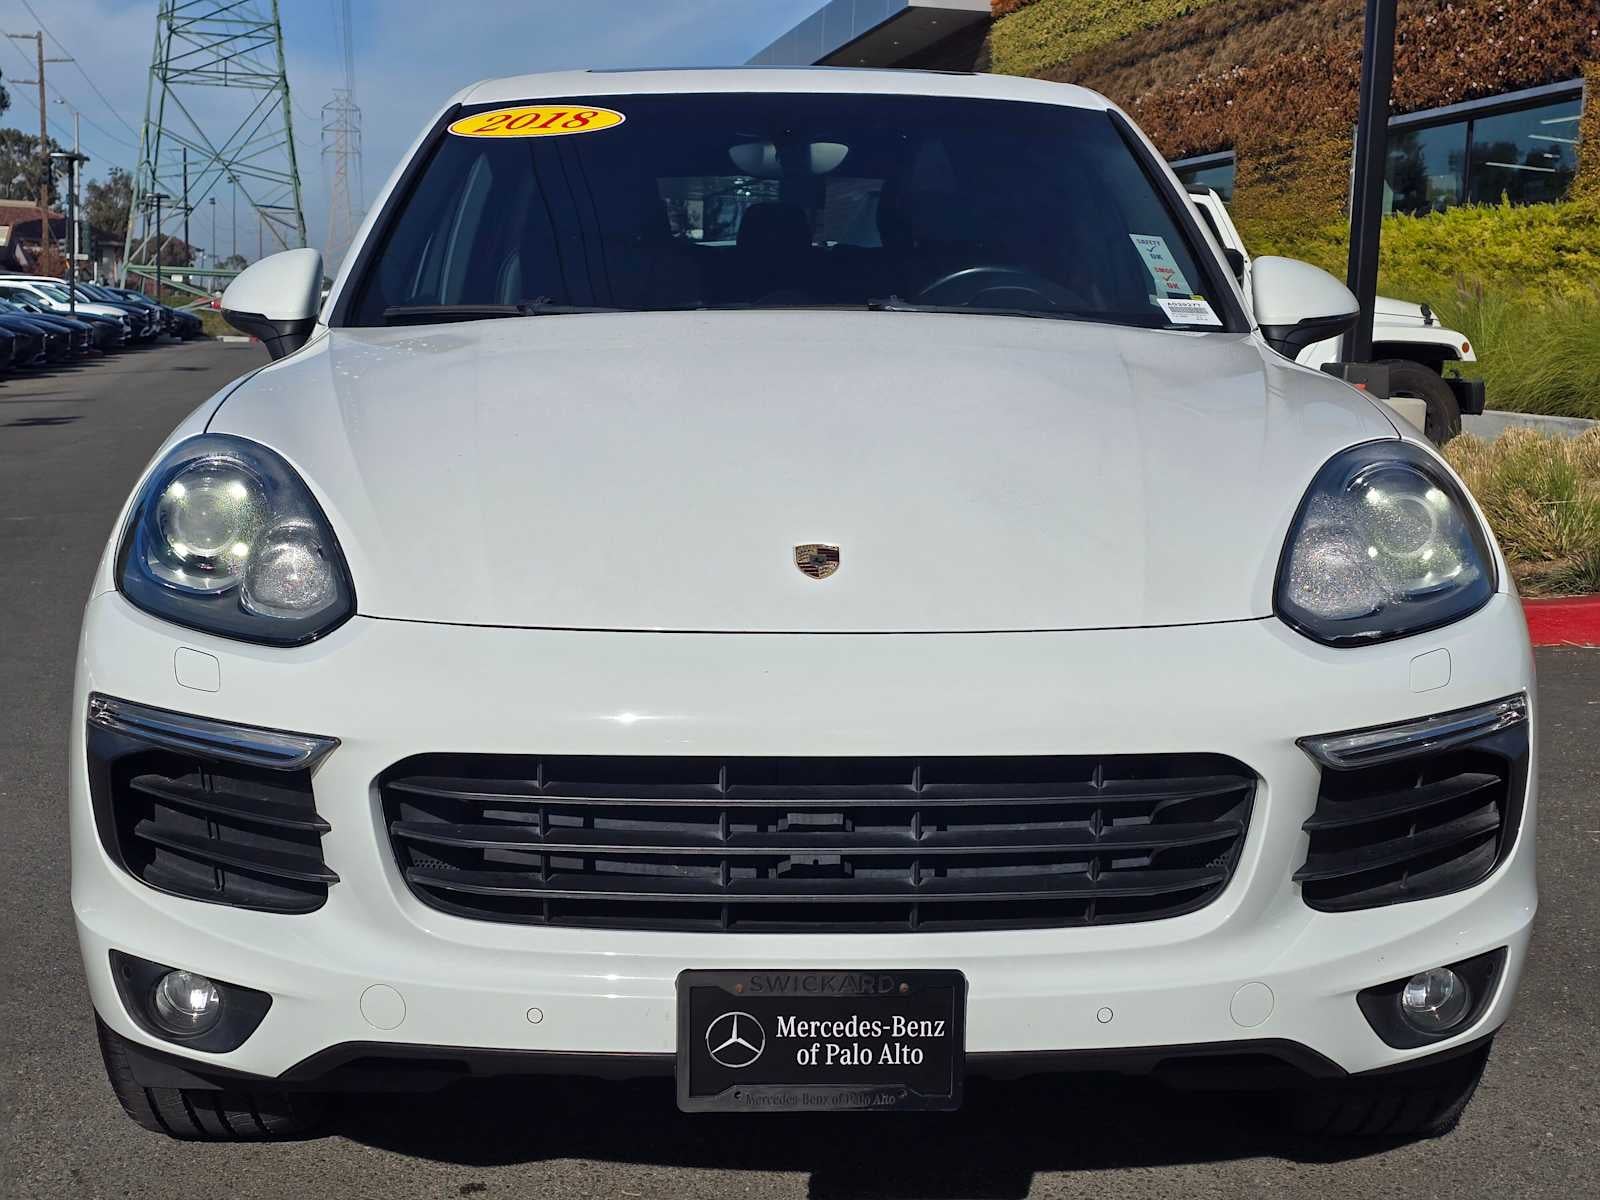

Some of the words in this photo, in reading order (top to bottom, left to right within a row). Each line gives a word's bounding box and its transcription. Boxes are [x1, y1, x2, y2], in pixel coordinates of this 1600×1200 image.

[472, 110, 599, 133] 2018
[1136, 238, 1161, 247] SAFETY
[749, 975, 896, 993] SWICKARD
[775, 1015, 946, 1038] Mercedes-Benz
[796, 1042, 821, 1066] of
[824, 1042, 873, 1066] Palo
[877, 1042, 924, 1066] Alto
[872, 1094, 897, 1106] Alto
